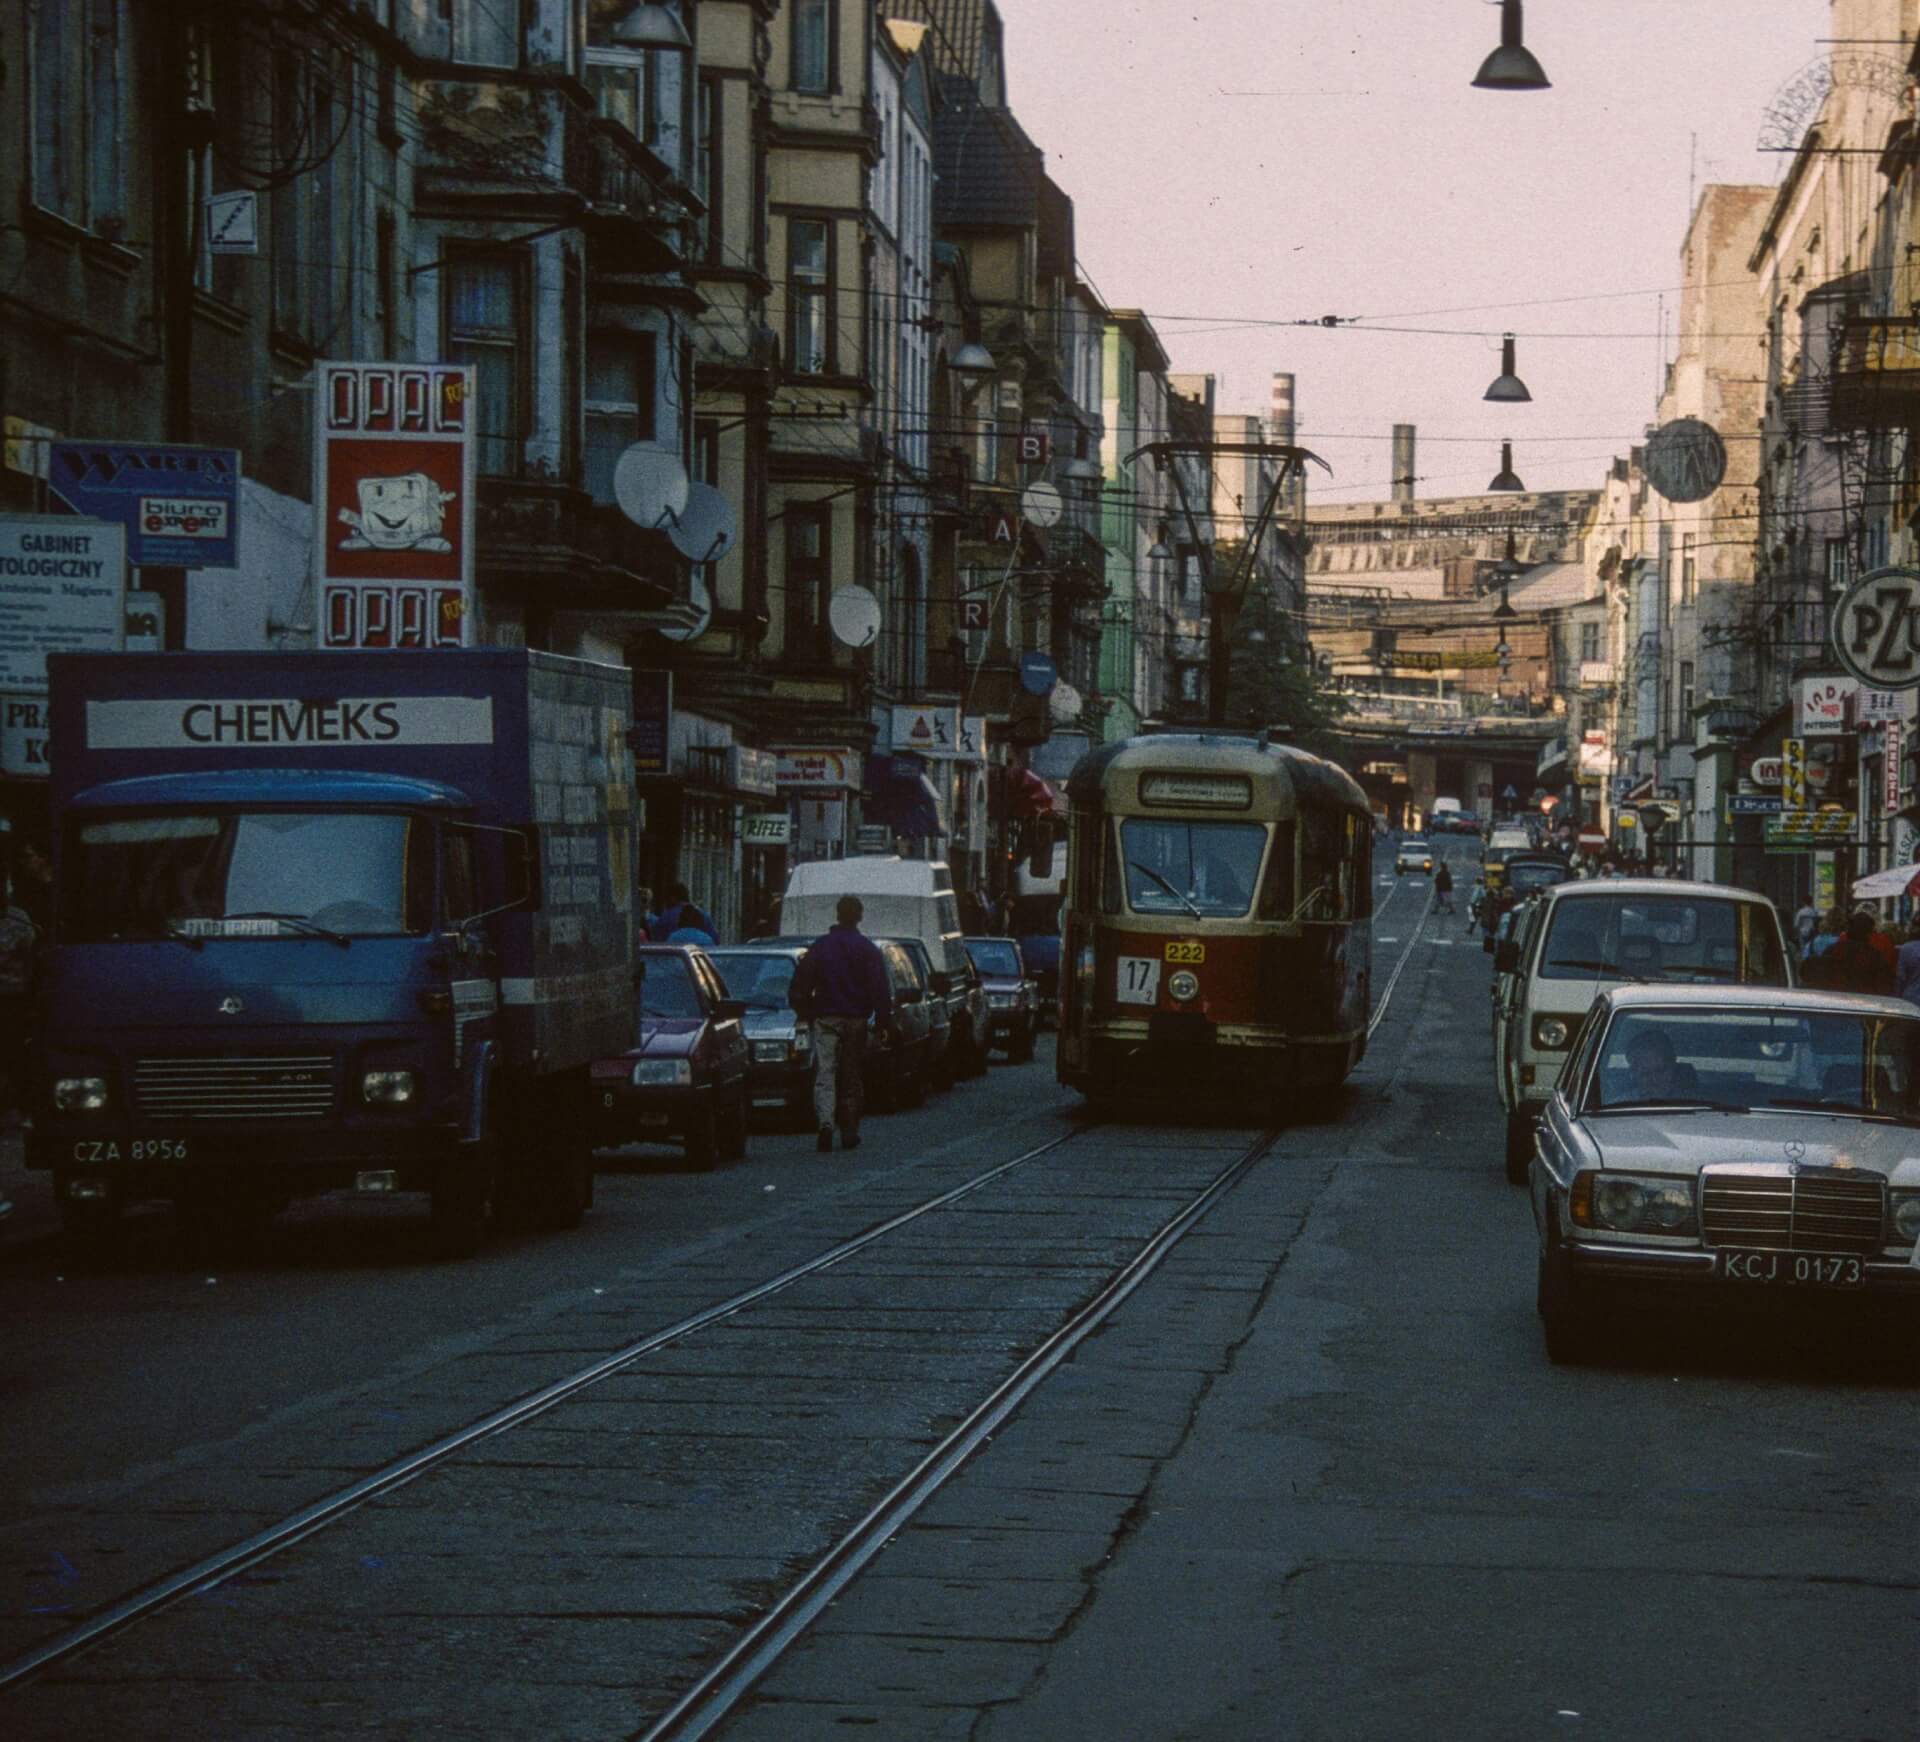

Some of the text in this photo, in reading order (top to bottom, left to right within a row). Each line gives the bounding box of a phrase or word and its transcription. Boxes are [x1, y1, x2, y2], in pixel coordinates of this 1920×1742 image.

[328, 371, 463, 430] OPAL
[1023, 437, 1041, 460] B
[145, 502, 222, 517] biuro
[994, 519, 1011, 541] A
[21, 533, 91, 553] GABINET
[327, 588, 460, 646] OPAL
[965, 603, 982, 625] R
[182, 701, 400, 743] CHEMEKS
[1167, 945, 1203, 961] 222
[1127, 961, 1151, 990] 17
[73, 1139, 188, 1161] CZA 8956
[1724, 1253, 1860, 1283] KCJ 0173
